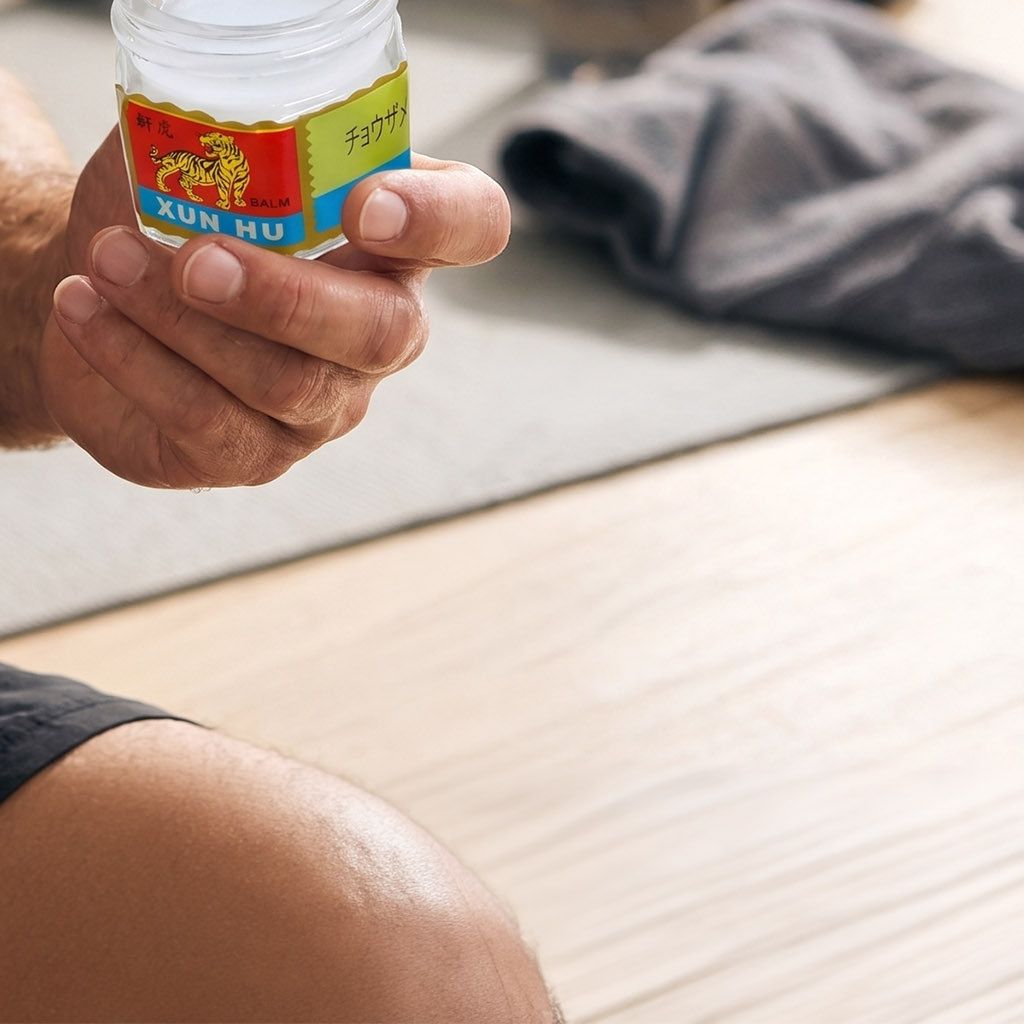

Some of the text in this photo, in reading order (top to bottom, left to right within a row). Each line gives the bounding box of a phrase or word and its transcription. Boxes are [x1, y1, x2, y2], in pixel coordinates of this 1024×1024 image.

[249, 198, 290, 209] BALM
[156, 196, 284, 241] XUN HU
